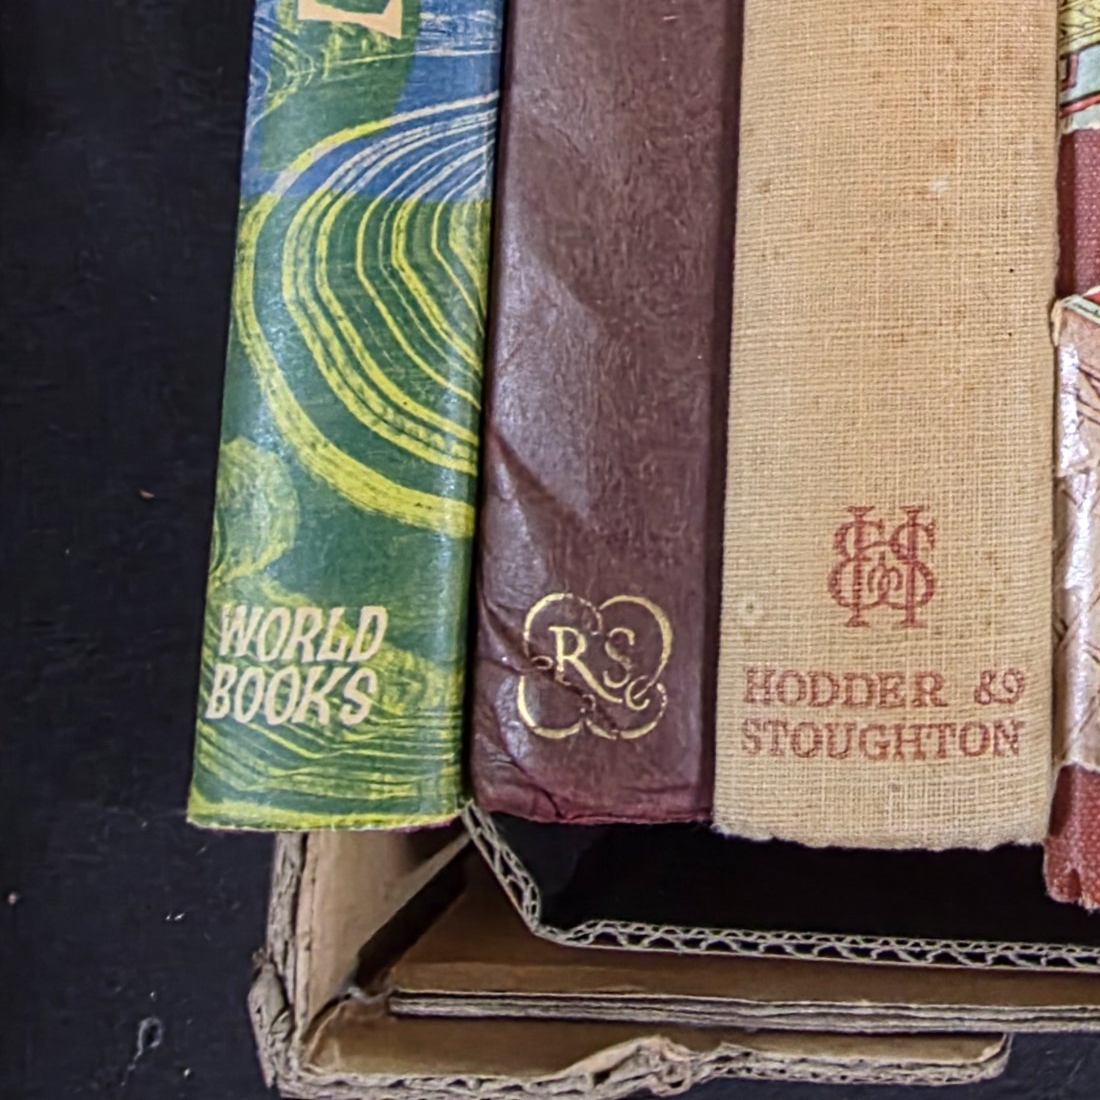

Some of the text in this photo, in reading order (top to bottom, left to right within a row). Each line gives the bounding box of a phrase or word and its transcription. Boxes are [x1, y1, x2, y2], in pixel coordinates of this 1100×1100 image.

[218, 605, 388, 663] WORLD
[205, 665, 378, 726] BOOKS
[743, 667, 947, 708] HODDER
[741, 718, 1023, 760] STOUGHTON
